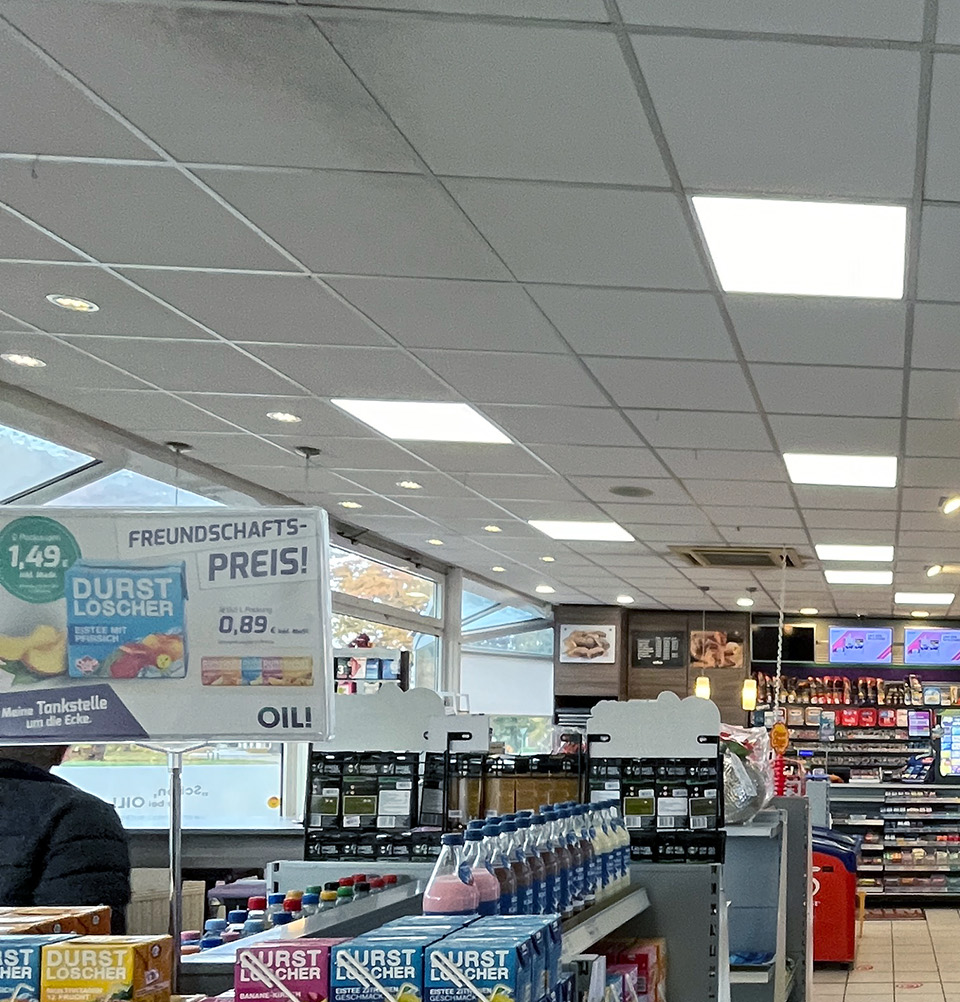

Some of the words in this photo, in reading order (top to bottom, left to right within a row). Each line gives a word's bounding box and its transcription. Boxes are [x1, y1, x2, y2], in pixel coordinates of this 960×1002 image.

[129, 518, 307, 548] FREUNDSCHAFTS-
[9, 545, 60, 570] 1,49
[208, 546, 309, 581] PREIS!
[73, 577, 173, 600] DURST
[219, 616, 268, 635] 0,89
[1, 706, 34, 718] Meine
[36, 695, 108, 715] Tankstelle
[257, 706, 312, 729] OIL!
[26, 719, 44, 729] um
[45, 715, 62, 727] die
[64, 713, 92, 726] Ecke.
[47, 950, 128, 967] DURST
